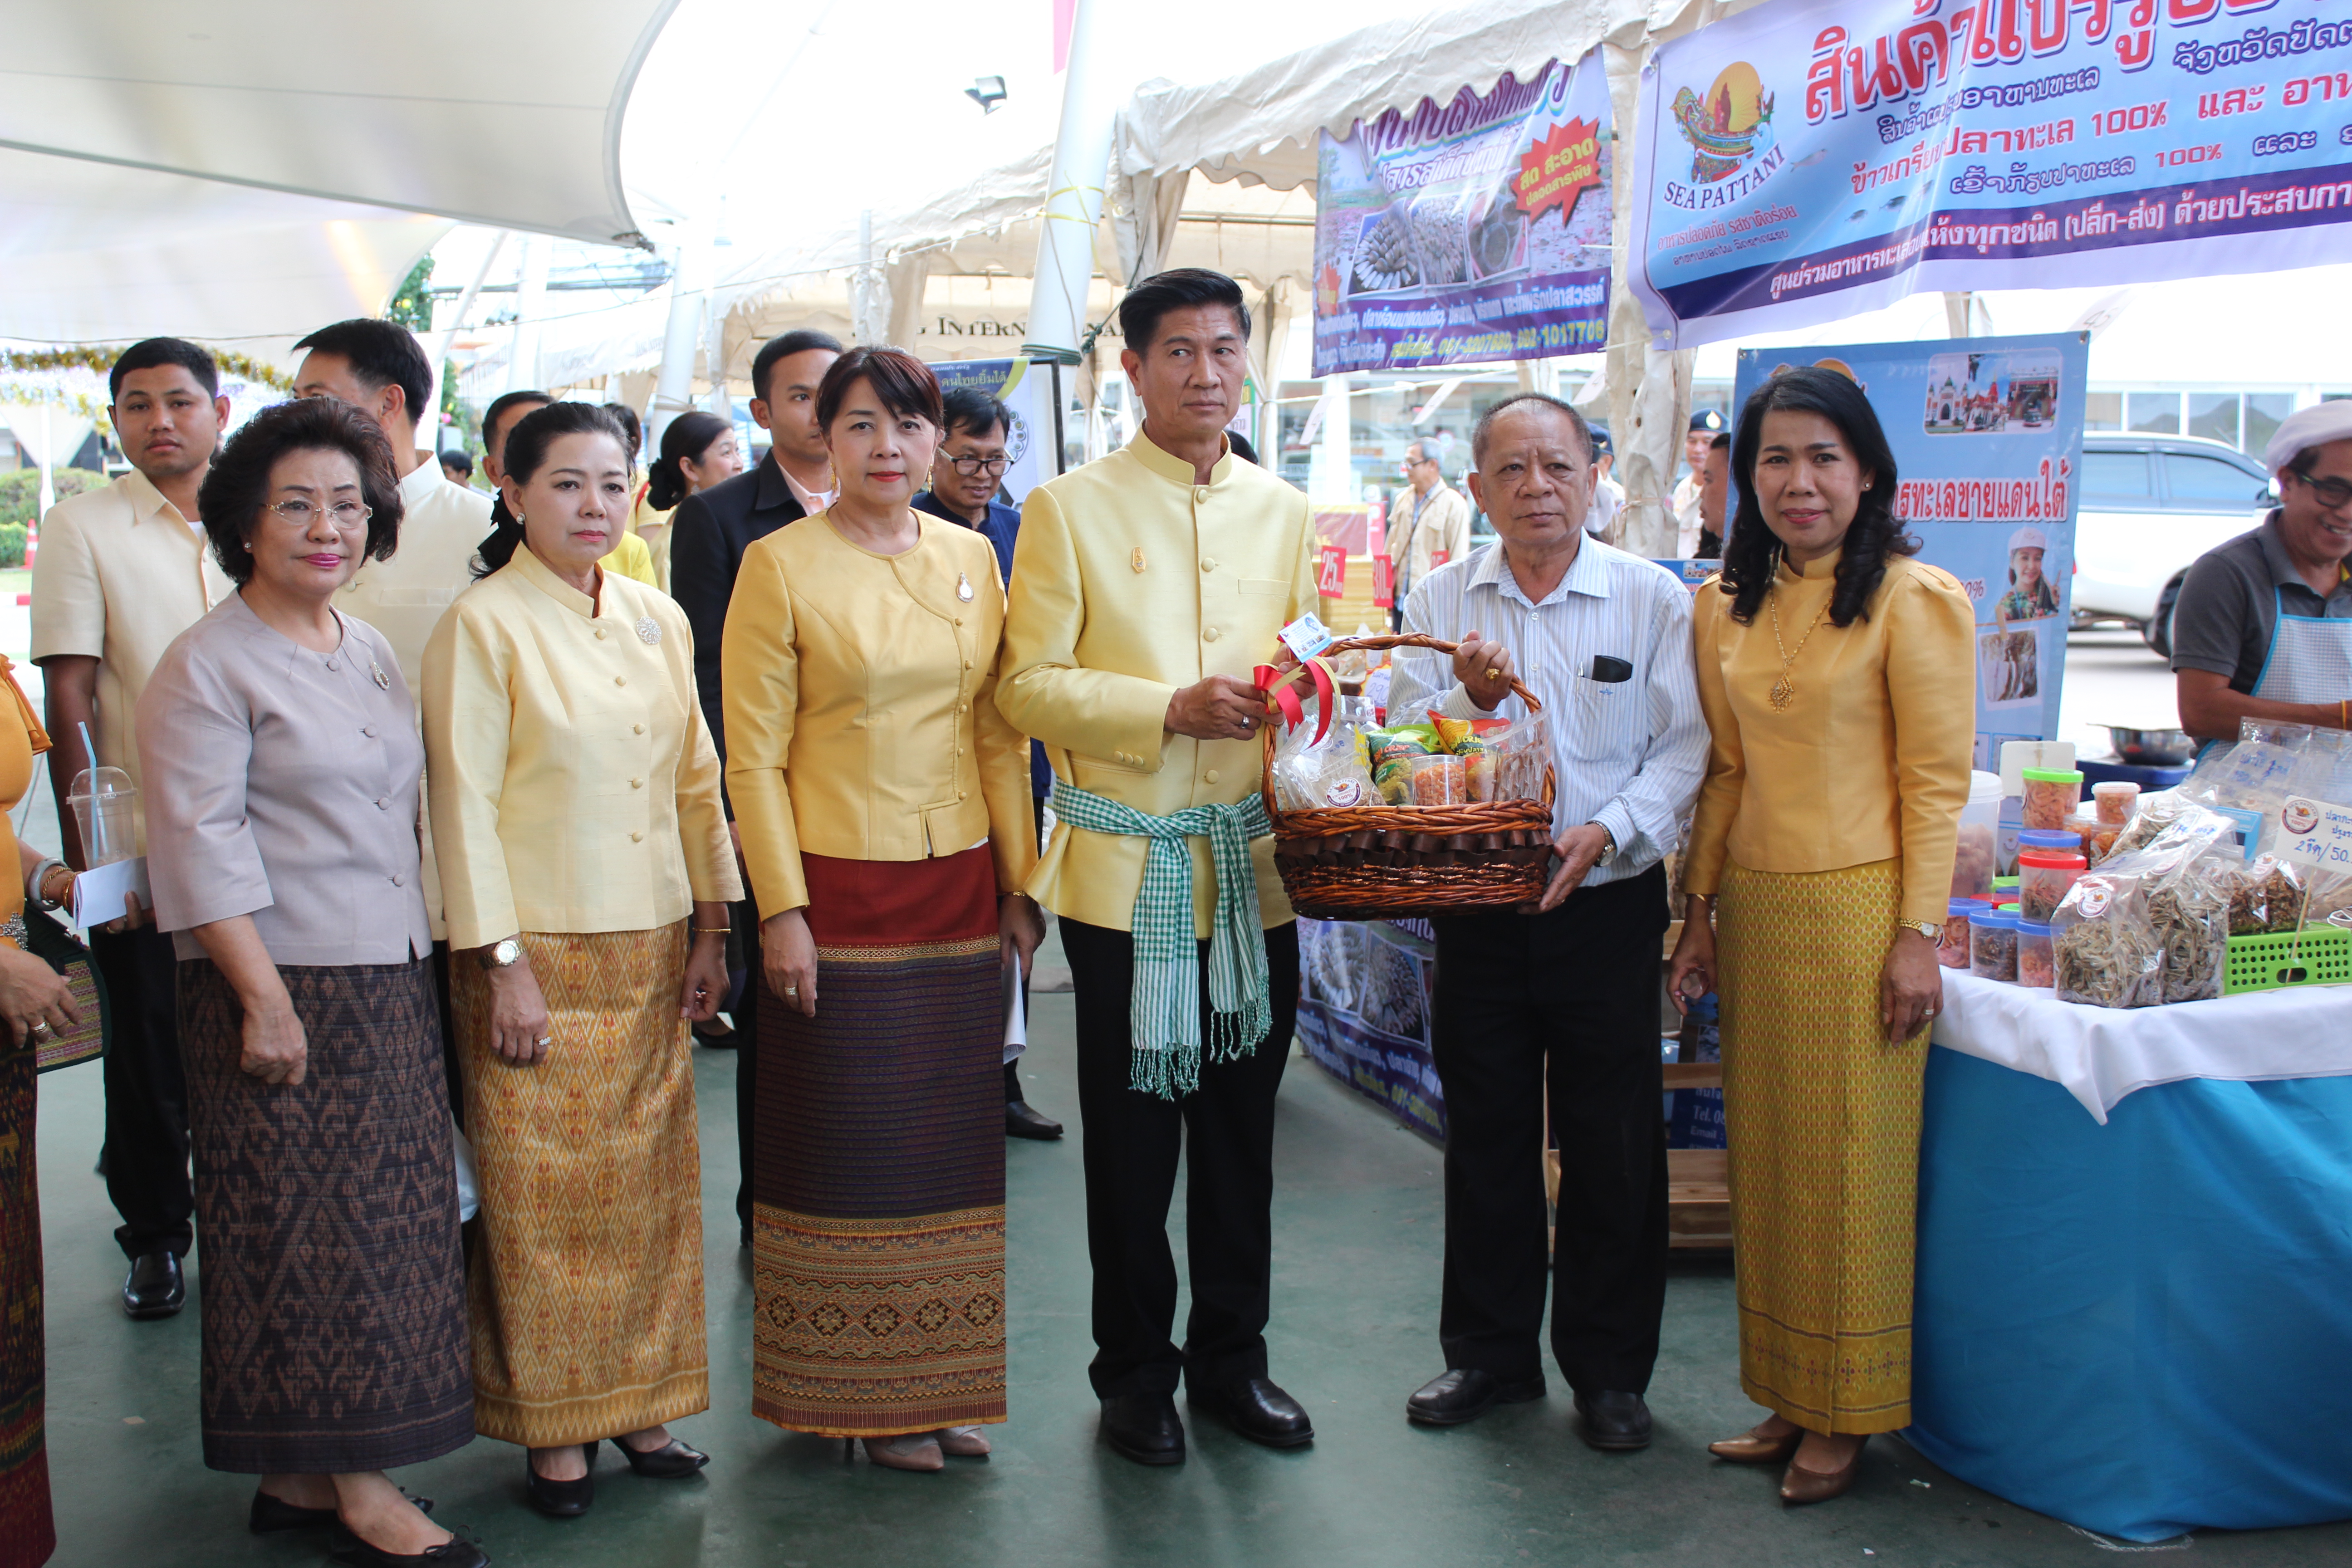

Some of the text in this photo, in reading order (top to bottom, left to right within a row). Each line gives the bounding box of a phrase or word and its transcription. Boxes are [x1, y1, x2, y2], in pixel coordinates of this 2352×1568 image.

[2091, 102, 2167, 137] 100%
[2198, 85, 2265, 119] และ
[1520, 137, 1594, 190] สด สะอาด
[1664, 143, 1785, 209] SEA PATTANI
[2155, 143, 2222, 168] 100%
[1526, 164, 1591, 206] ปลอดสารพิษ
[1658, 204, 1798, 250] อาหารปลอดภัย รสชาติอร่อย
[941, 368, 1007, 386] คนไทยยิ้มได้
[1319, 550, 1339, 592] 25
[1690, 1126, 1717, 1139] Email
[1693, 1104, 1711, 1122] Tel.
